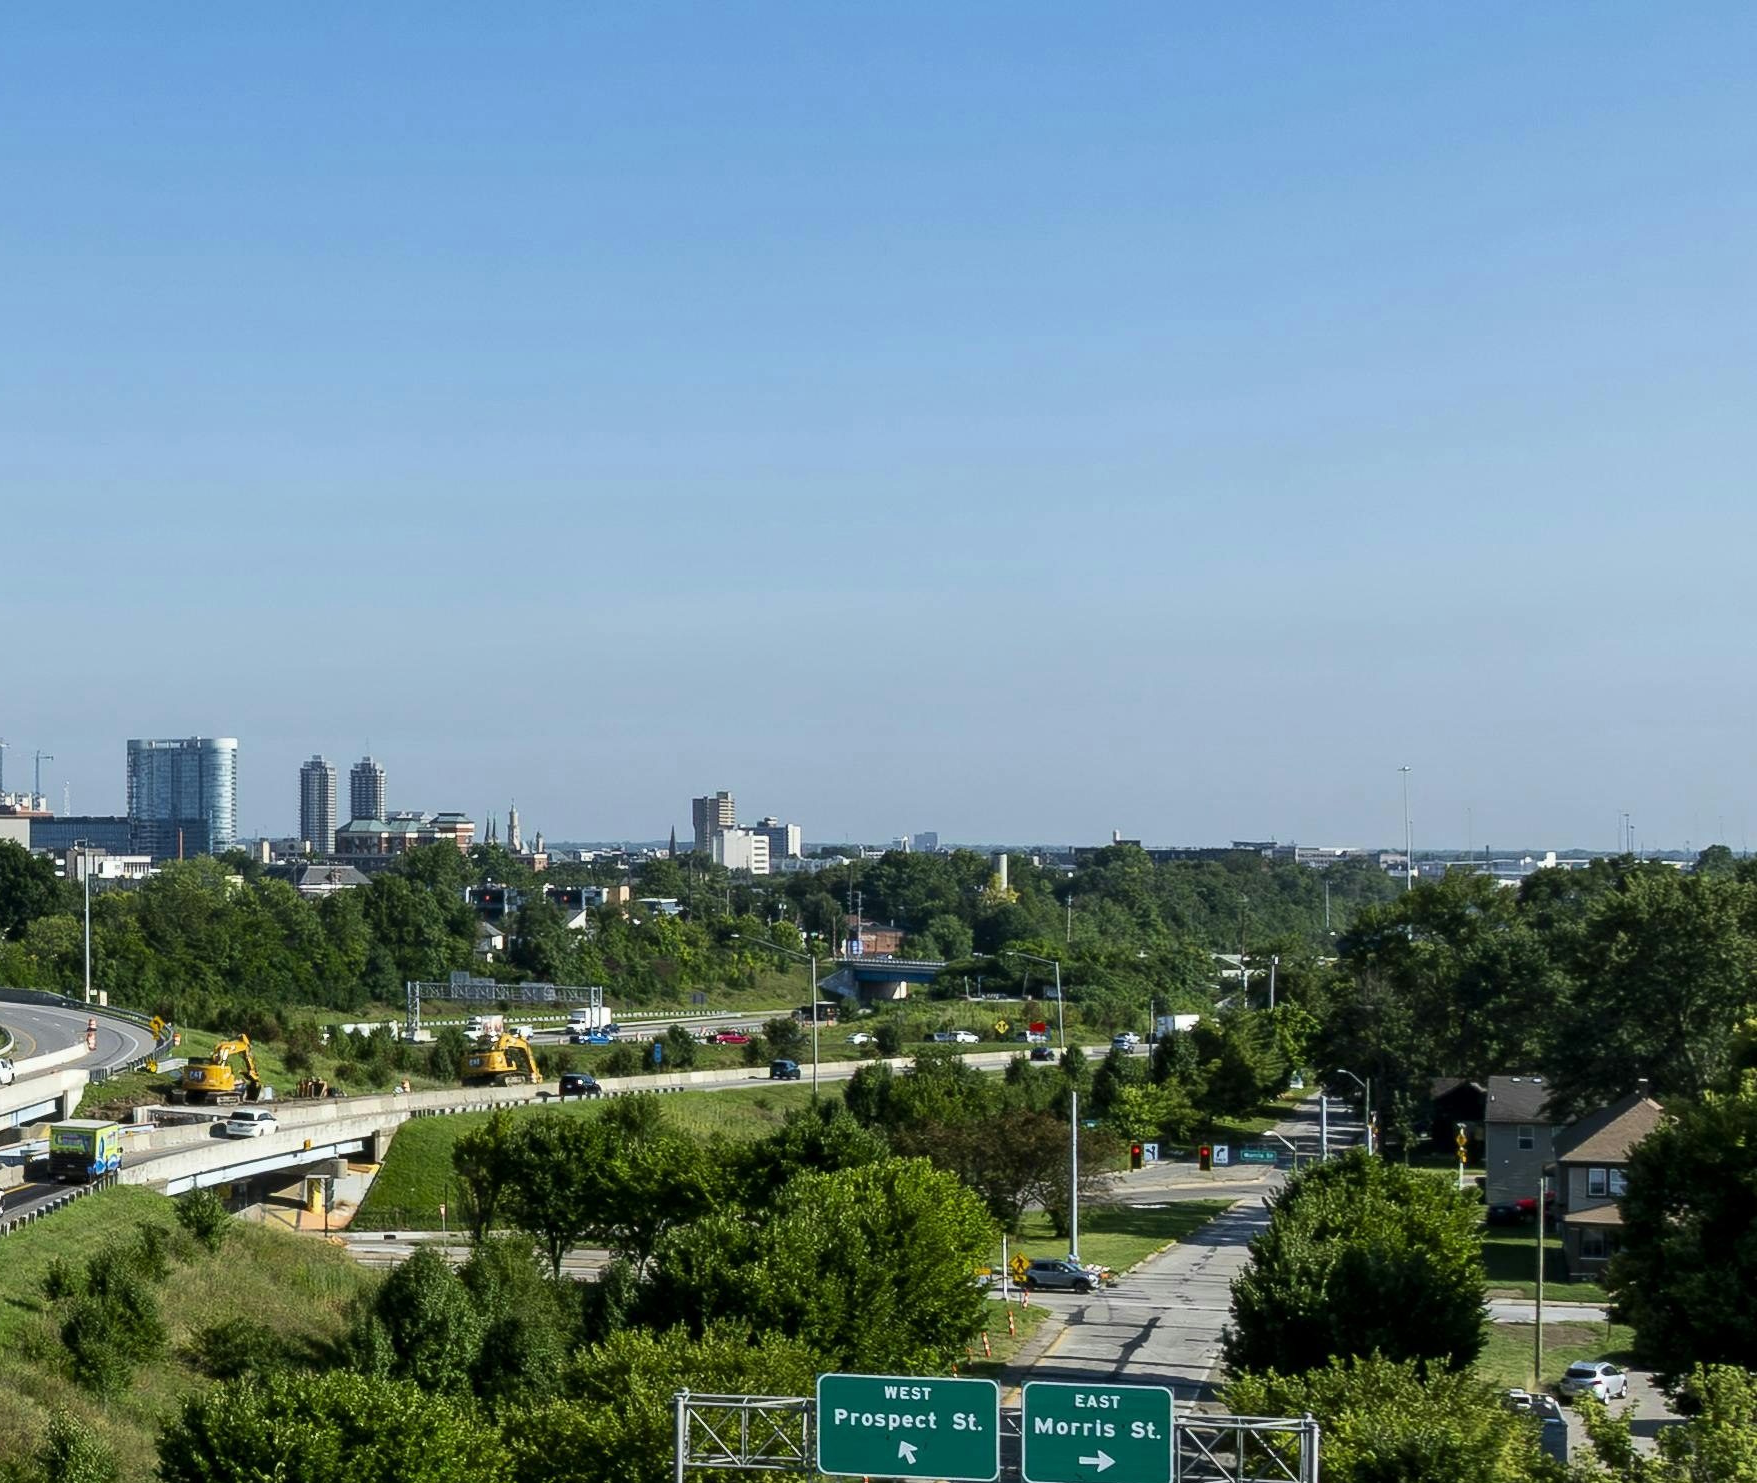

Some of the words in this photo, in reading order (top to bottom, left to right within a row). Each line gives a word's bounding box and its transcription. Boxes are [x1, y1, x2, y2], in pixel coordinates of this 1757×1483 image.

[189, 1070, 203, 1081] CAT
[885, 1386, 932, 1401] WEST
[1075, 1394, 1121, 1409] EAST
[835, 1408, 937, 1431] Prospect
[952, 1413, 983, 1431] St.
[1034, 1416, 1116, 1438] Morris
[1131, 1421, 1162, 1440] St.
